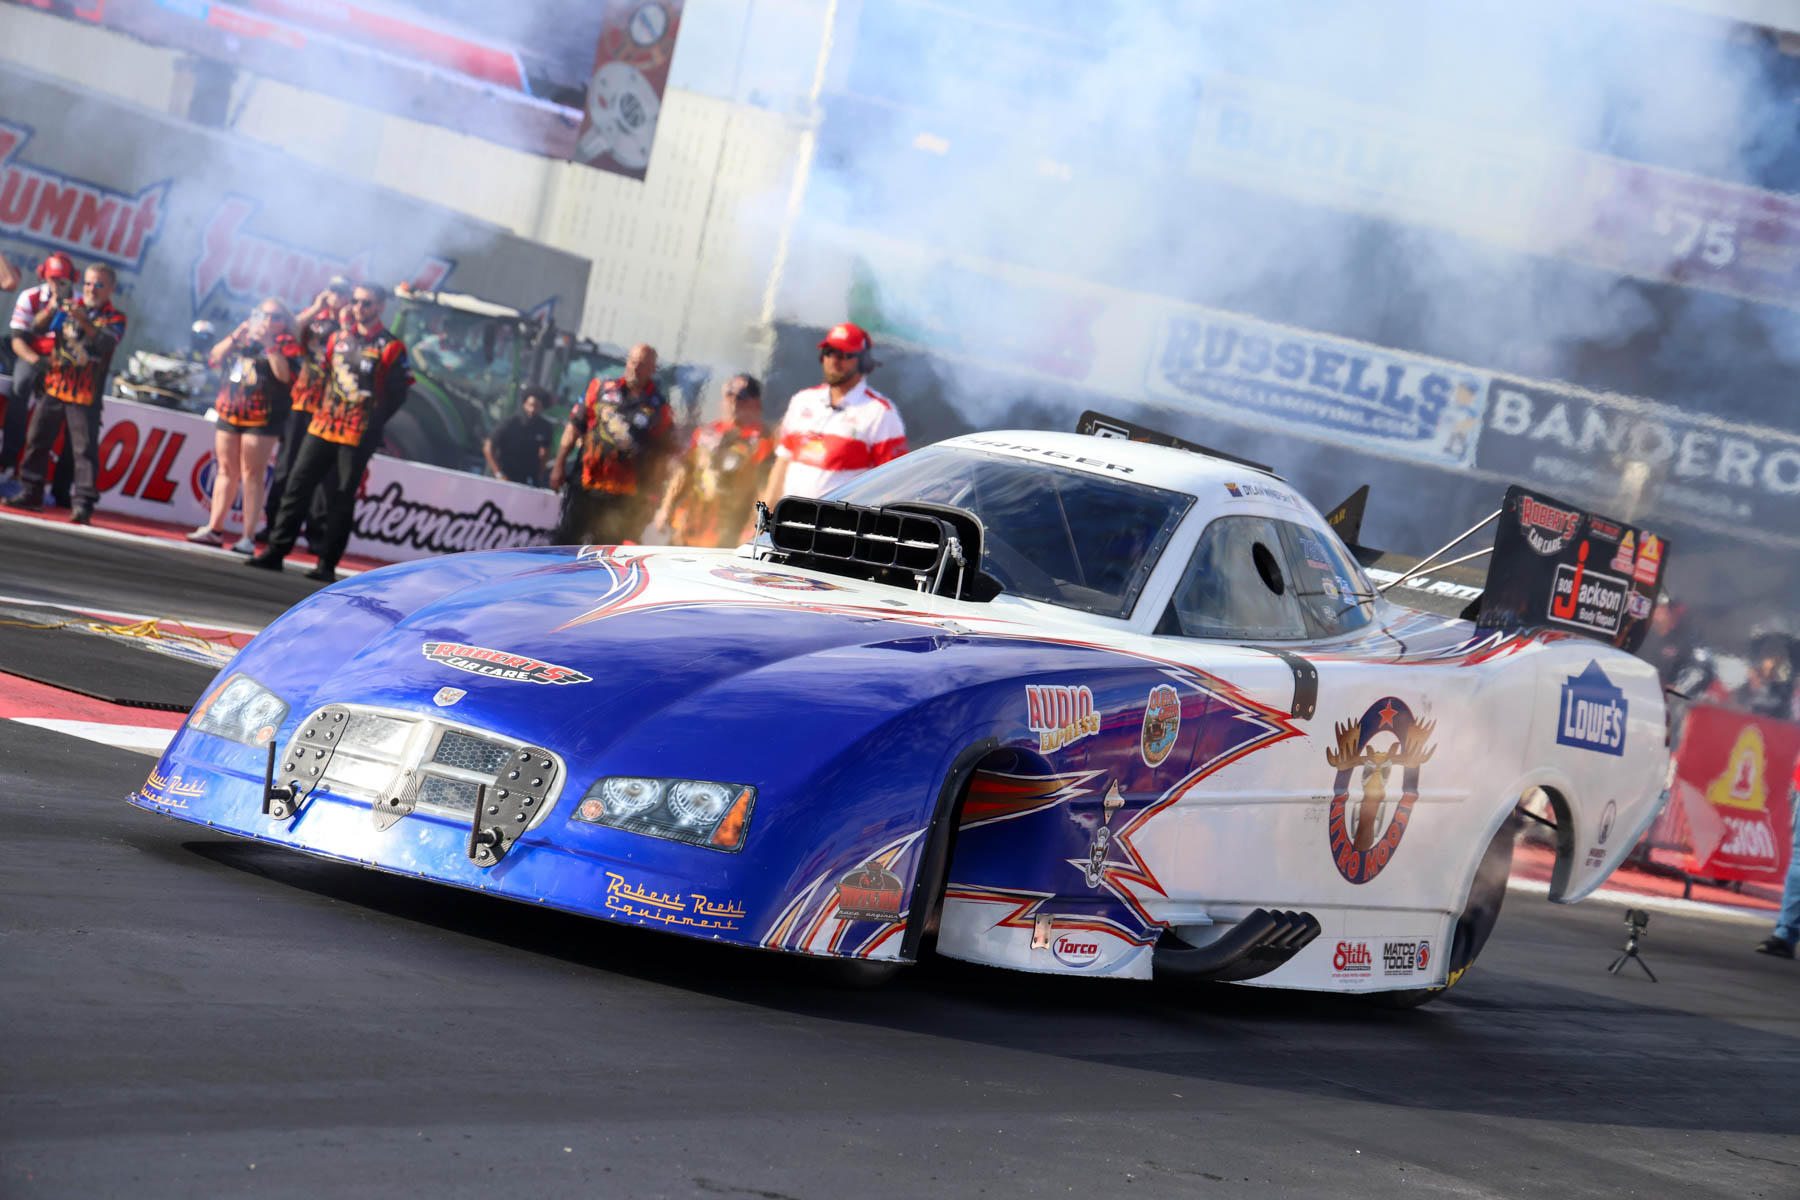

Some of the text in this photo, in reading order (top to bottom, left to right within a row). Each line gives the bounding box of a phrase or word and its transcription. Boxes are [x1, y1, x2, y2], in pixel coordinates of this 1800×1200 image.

[1157, 312, 1452, 428] RUSSELLS
[96, 420, 187, 502] OIL
[1528, 527, 1563, 554] CAR CARE
[1554, 540, 1621, 619] Jackson
[445, 656, 531, 680] CAR CARE
[1027, 687, 1092, 729] AUDIO
[1564, 688, 1623, 749] LOWE'S
[1040, 713, 1100, 752] EXPRESS
[1330, 793, 1361, 880] NITRO
[604, 895, 740, 931] Equipment
[605, 871, 747, 918] Robert Reehl
[1058, 938, 1098, 956] Torco
[1333, 941, 1372, 971] Stith
[1383, 943, 1416, 956] MATCO
[1383, 956, 1414, 969] TOOLS
